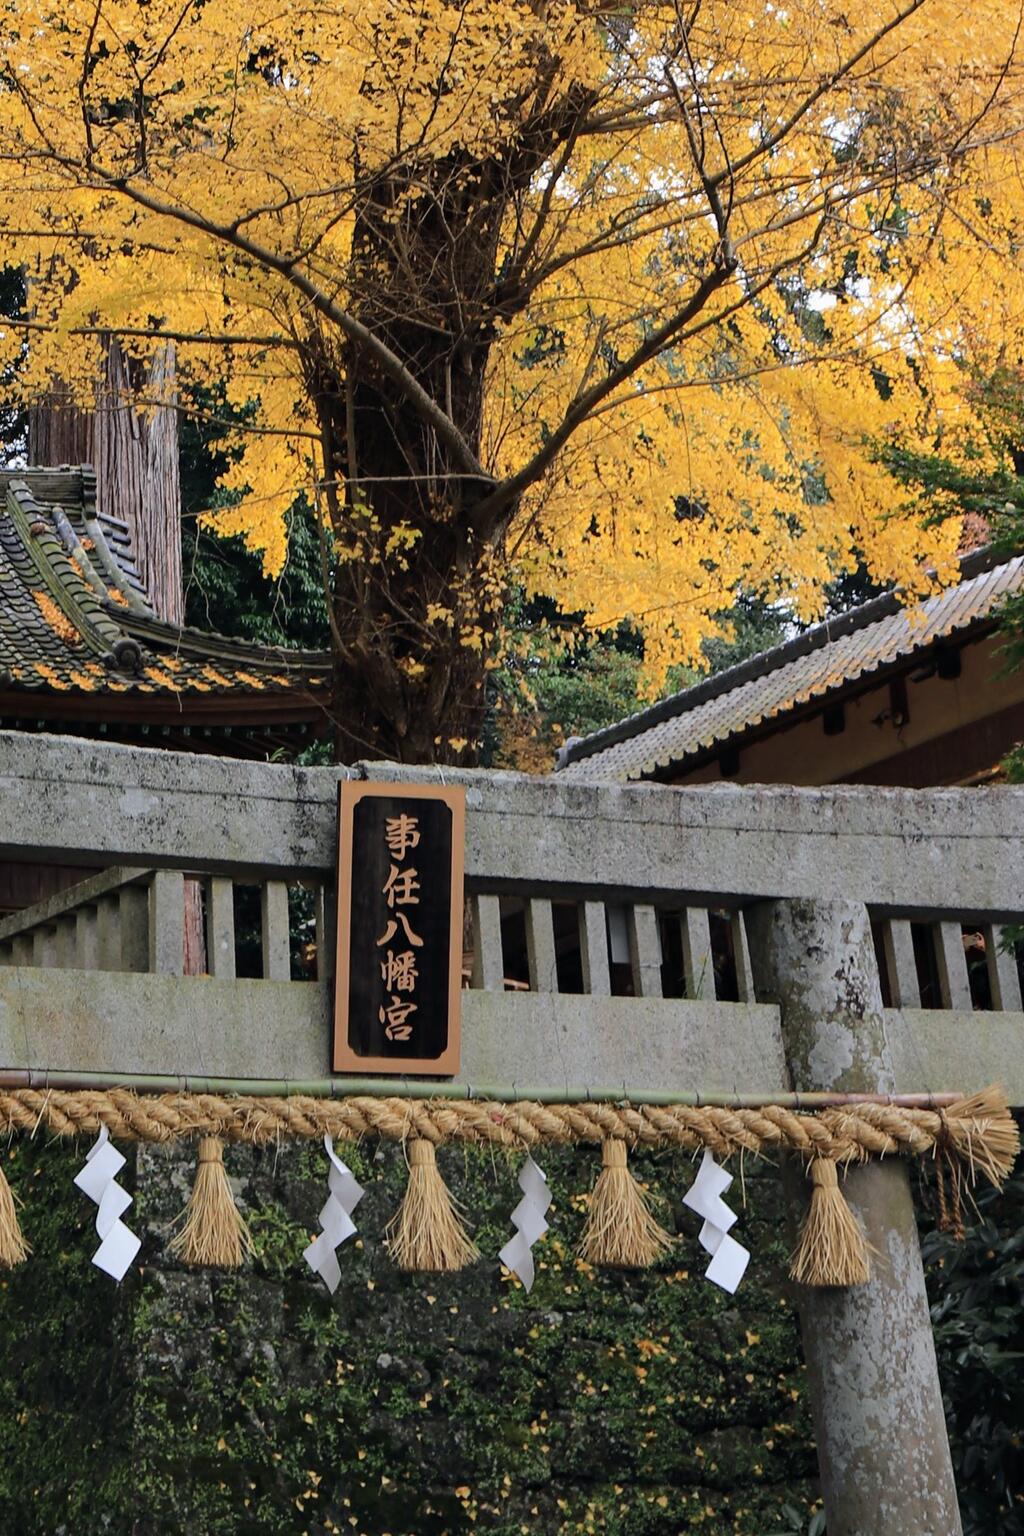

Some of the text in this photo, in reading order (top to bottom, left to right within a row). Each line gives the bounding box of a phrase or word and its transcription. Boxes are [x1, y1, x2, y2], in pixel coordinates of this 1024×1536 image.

[377, 814, 424, 1041] 事任八幡宮
